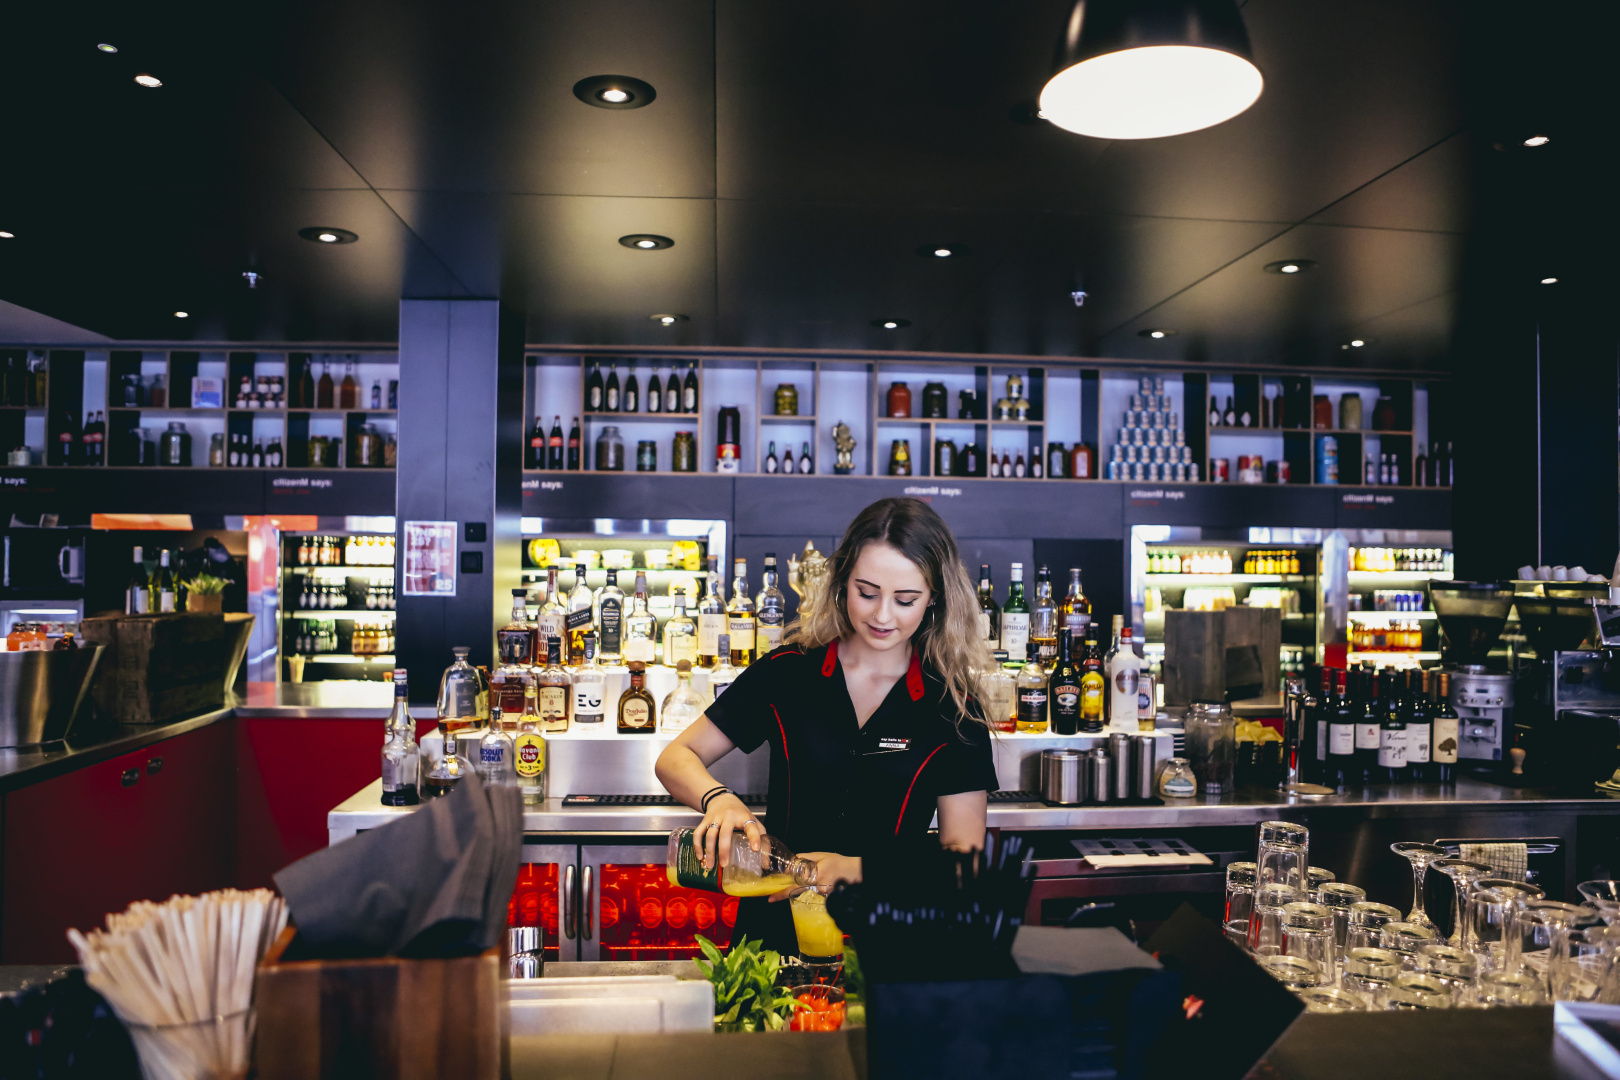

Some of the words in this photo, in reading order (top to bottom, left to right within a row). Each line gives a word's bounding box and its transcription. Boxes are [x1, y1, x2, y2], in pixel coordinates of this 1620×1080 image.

[4, 477, 27, 486] says:
[273, 478, 309, 487] citizenM
[310, 479, 333, 489] says:
[541, 481, 564, 491] says:
[904, 486, 939, 496] citizenM
[940, 488, 962, 498] says:
[1130, 489, 1164, 499] citizenM
[1165, 490, 1185, 500] says:
[540, 624, 555, 632] WILD
[480, 748, 505, 756] ABSOLUT
